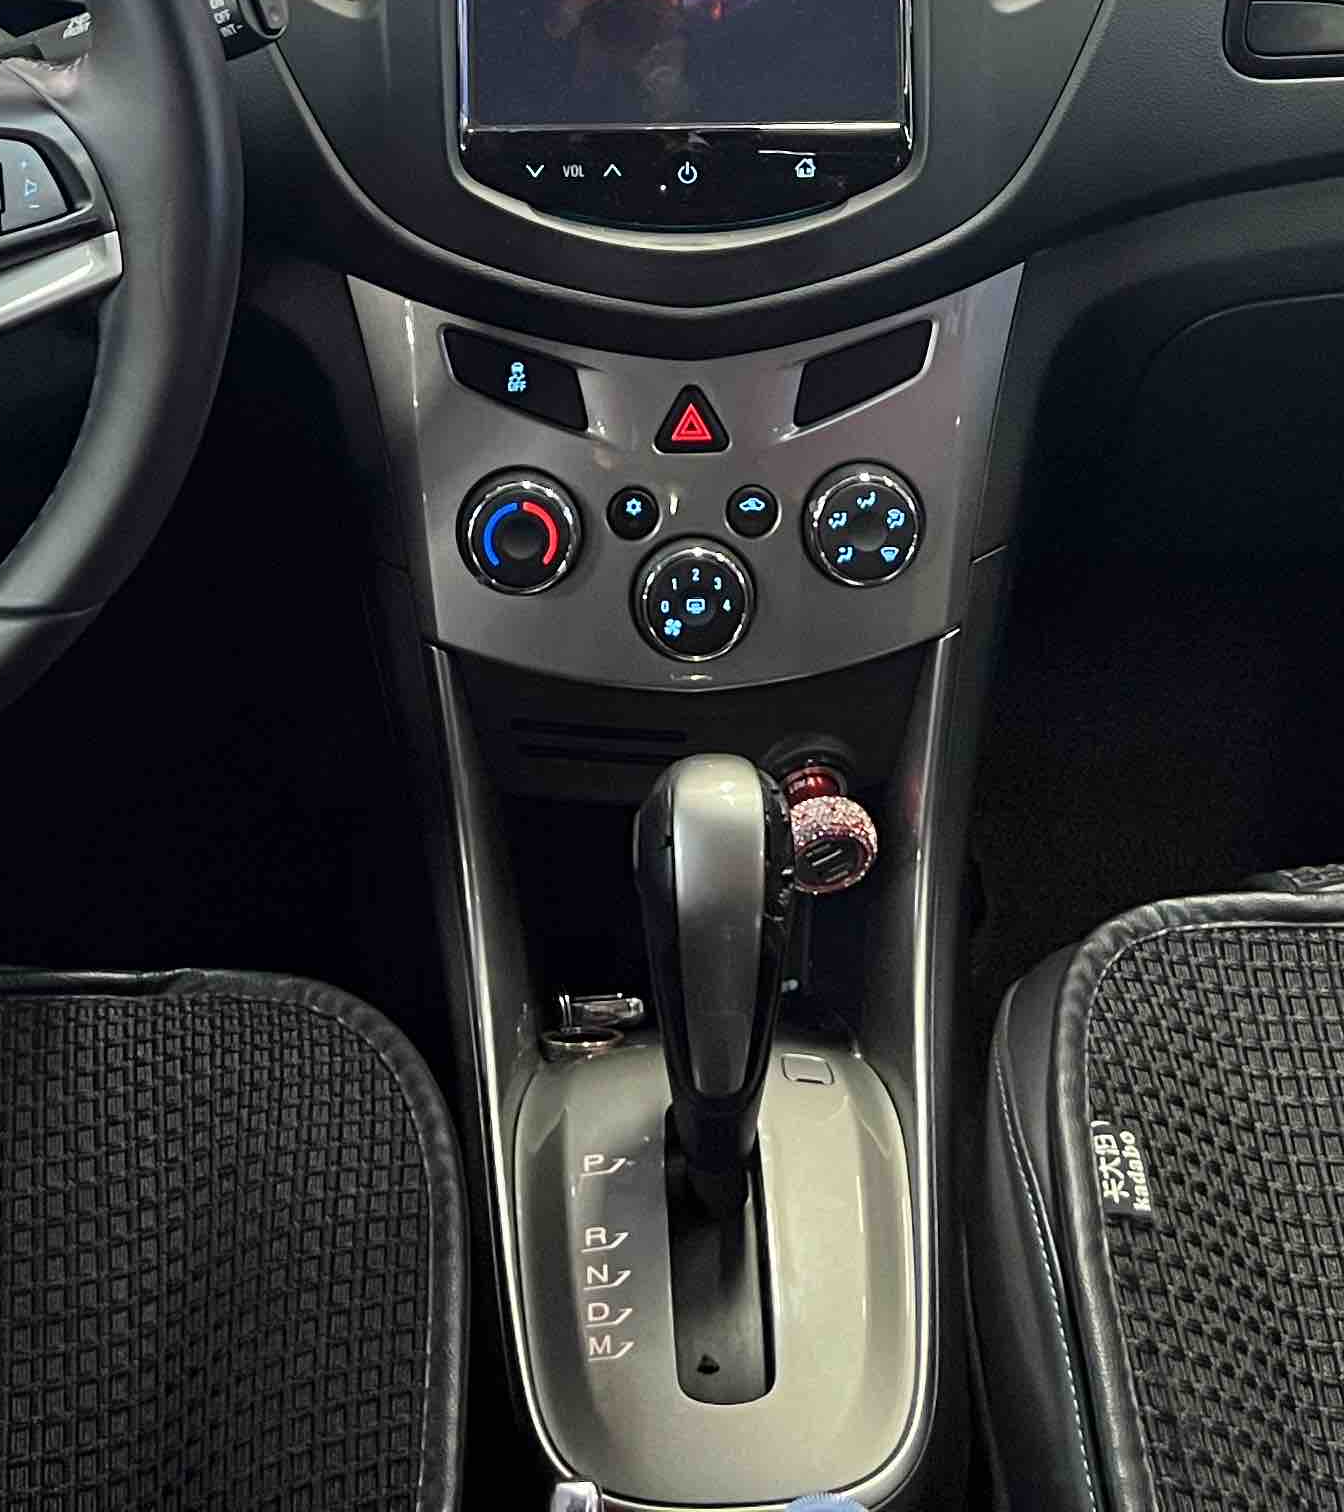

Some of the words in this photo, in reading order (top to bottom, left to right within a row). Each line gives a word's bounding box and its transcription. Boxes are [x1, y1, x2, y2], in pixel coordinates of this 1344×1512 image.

[562, 163, 585, 178] VOL
[691, 567, 701, 582] 2
[671, 577, 678, 591] 1
[713, 576, 723, 591] 3
[660, 599, 670, 614] 0
[722, 598, 732, 612] 4
[583, 1153, 605, 1173] P
[1119, 1130, 1152, 1212] kadabo
[585, 1226, 607, 1247] R
[586, 1263, 609, 1285] N
[587, 1302, 610, 1322] D
[588, 1334, 612, 1356] M
